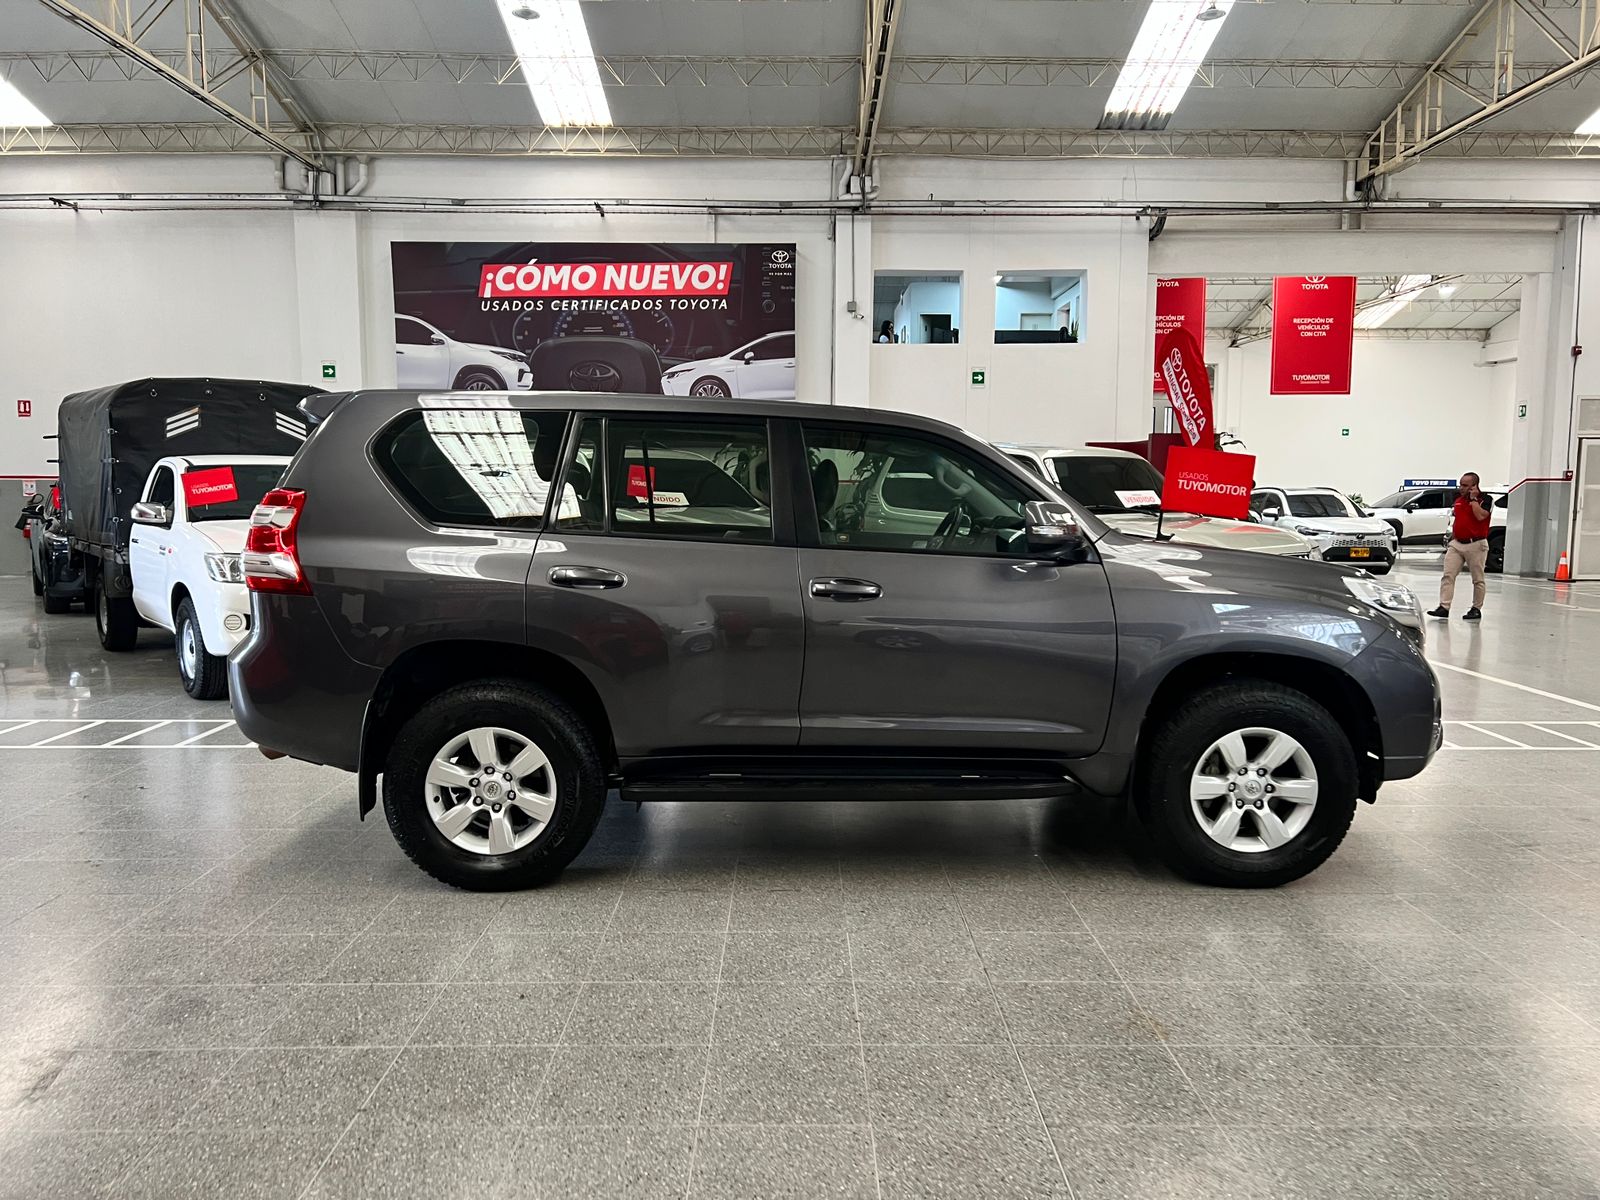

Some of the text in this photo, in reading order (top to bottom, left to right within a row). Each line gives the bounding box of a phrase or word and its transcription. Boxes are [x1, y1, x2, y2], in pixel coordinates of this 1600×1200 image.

[483, 258, 728, 298] ¡CÓMO NUEVO!
[481, 299, 728, 311] USADOS CERTIFICADOS TOYOTA
[1164, 362, 1180, 403] FINANCIAL
[1179, 368, 1207, 432] TOYOTA
[1178, 471, 1209, 481] USADOS
[191, 483, 234, 495] TUYOMOTOR
[1177, 479, 1247, 497] TUYOMOTOR
